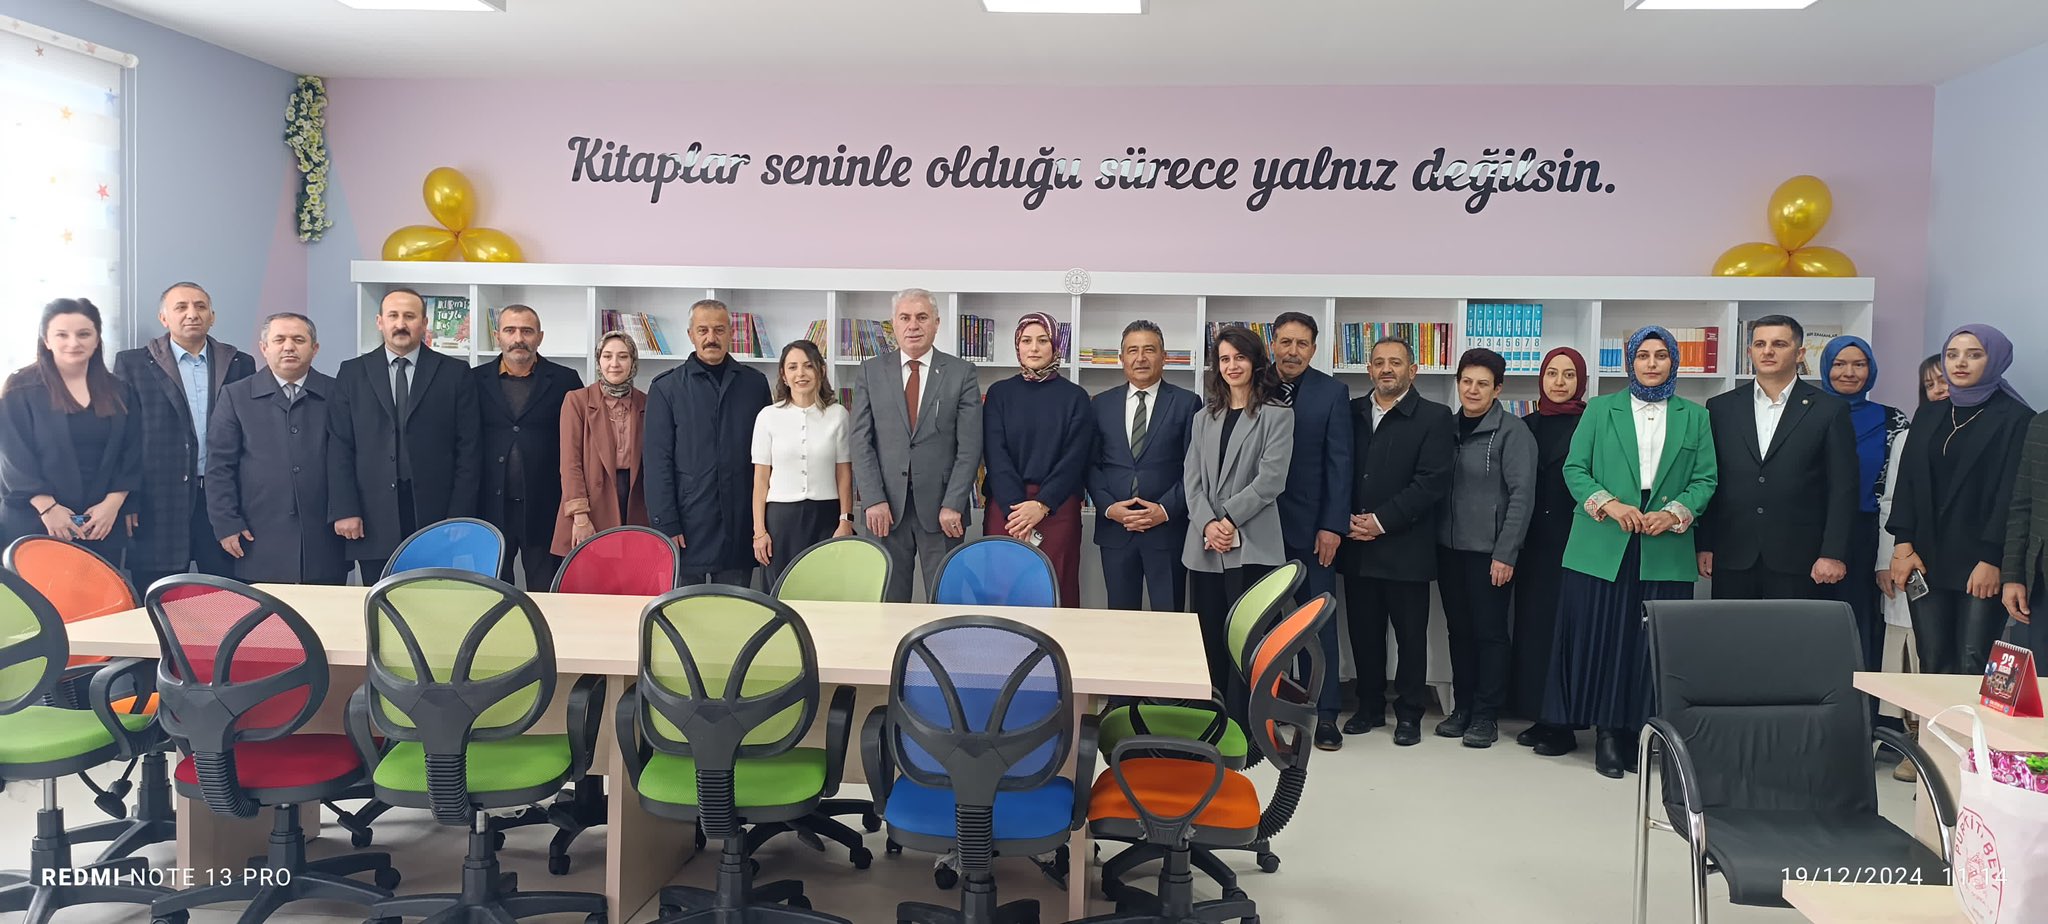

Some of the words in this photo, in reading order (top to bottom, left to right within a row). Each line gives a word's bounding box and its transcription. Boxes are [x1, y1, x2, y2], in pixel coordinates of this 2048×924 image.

[567, 136, 751, 204] Kitaplar
[760, 144, 913, 187] seninle
[926, 145, 1083, 211] olduğu
[1094, 146, 1239, 189] sürece
[1246, 145, 1399, 212] yalnız
[1412, 147, 1616, 214] değilsin.
[1468, 338, 1472, 346] 1
[1477, 338, 1482, 346] 2
[1486, 338, 1492, 346] 3
[1496, 338, 1501, 346] 4
[1506, 338, 1511, 346] 5
[1515, 338, 1520, 346] 6
[1524, 338, 1530, 346] 7
[1534, 338, 1540, 346] 8
